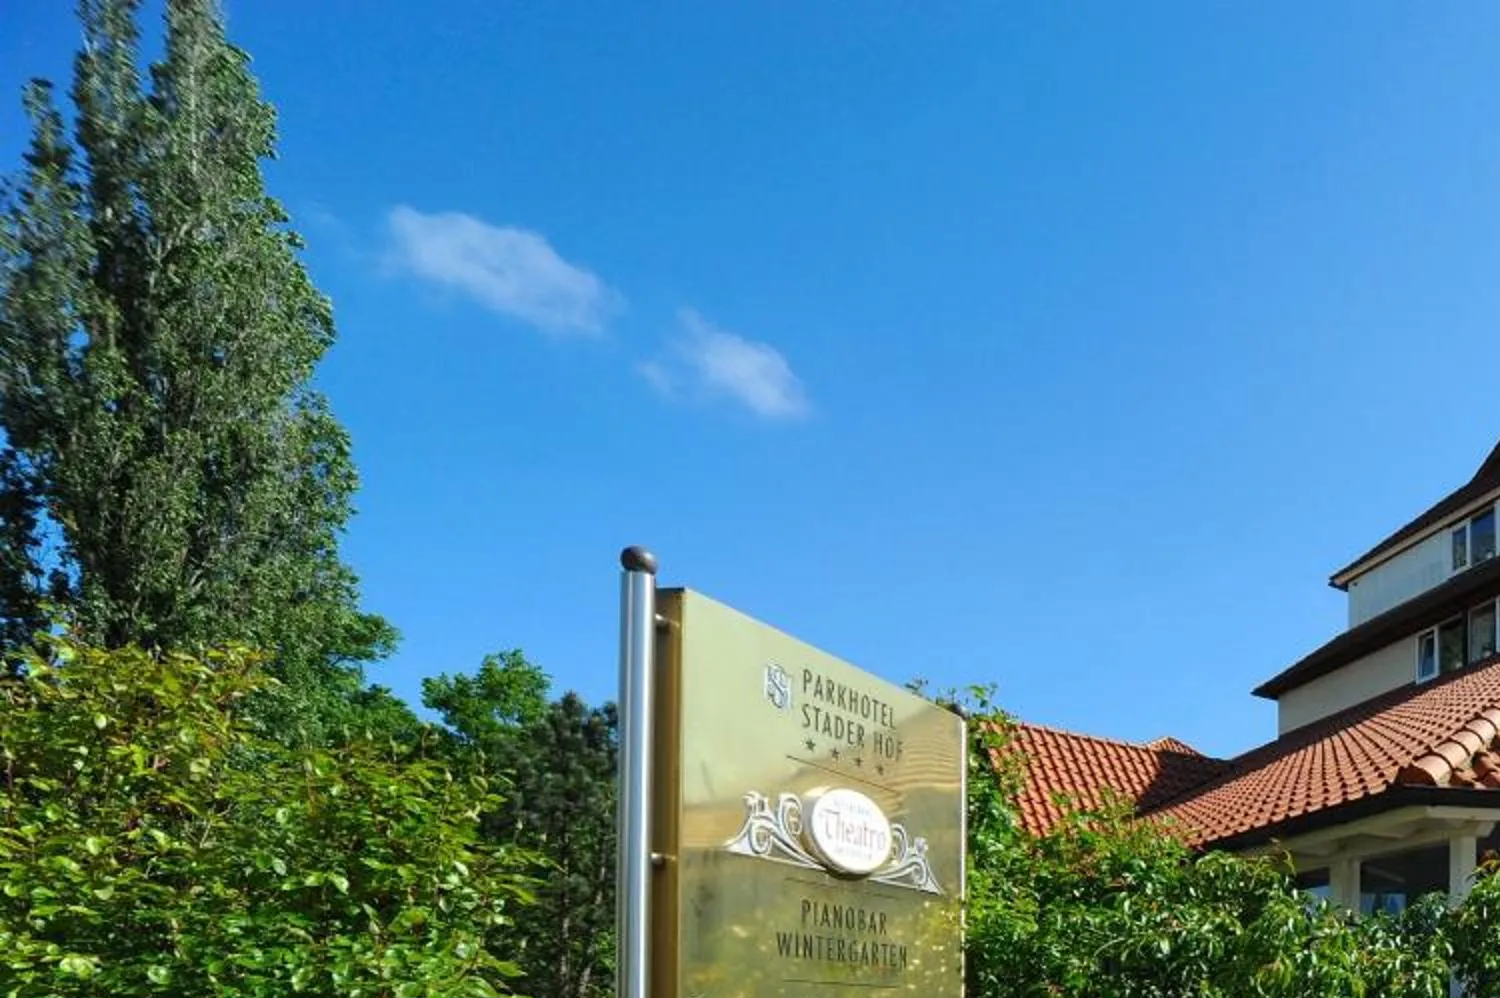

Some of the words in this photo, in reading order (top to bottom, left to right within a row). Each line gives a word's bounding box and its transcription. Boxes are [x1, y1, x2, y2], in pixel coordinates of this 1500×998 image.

[802, 668, 897, 729] PARKHOTEL
[802, 703, 865, 749] STADER
[873, 727, 903, 762] HOF
[800, 899, 888, 935] PIANOBAR
[775, 931, 908, 969] WINTERGARTEN
